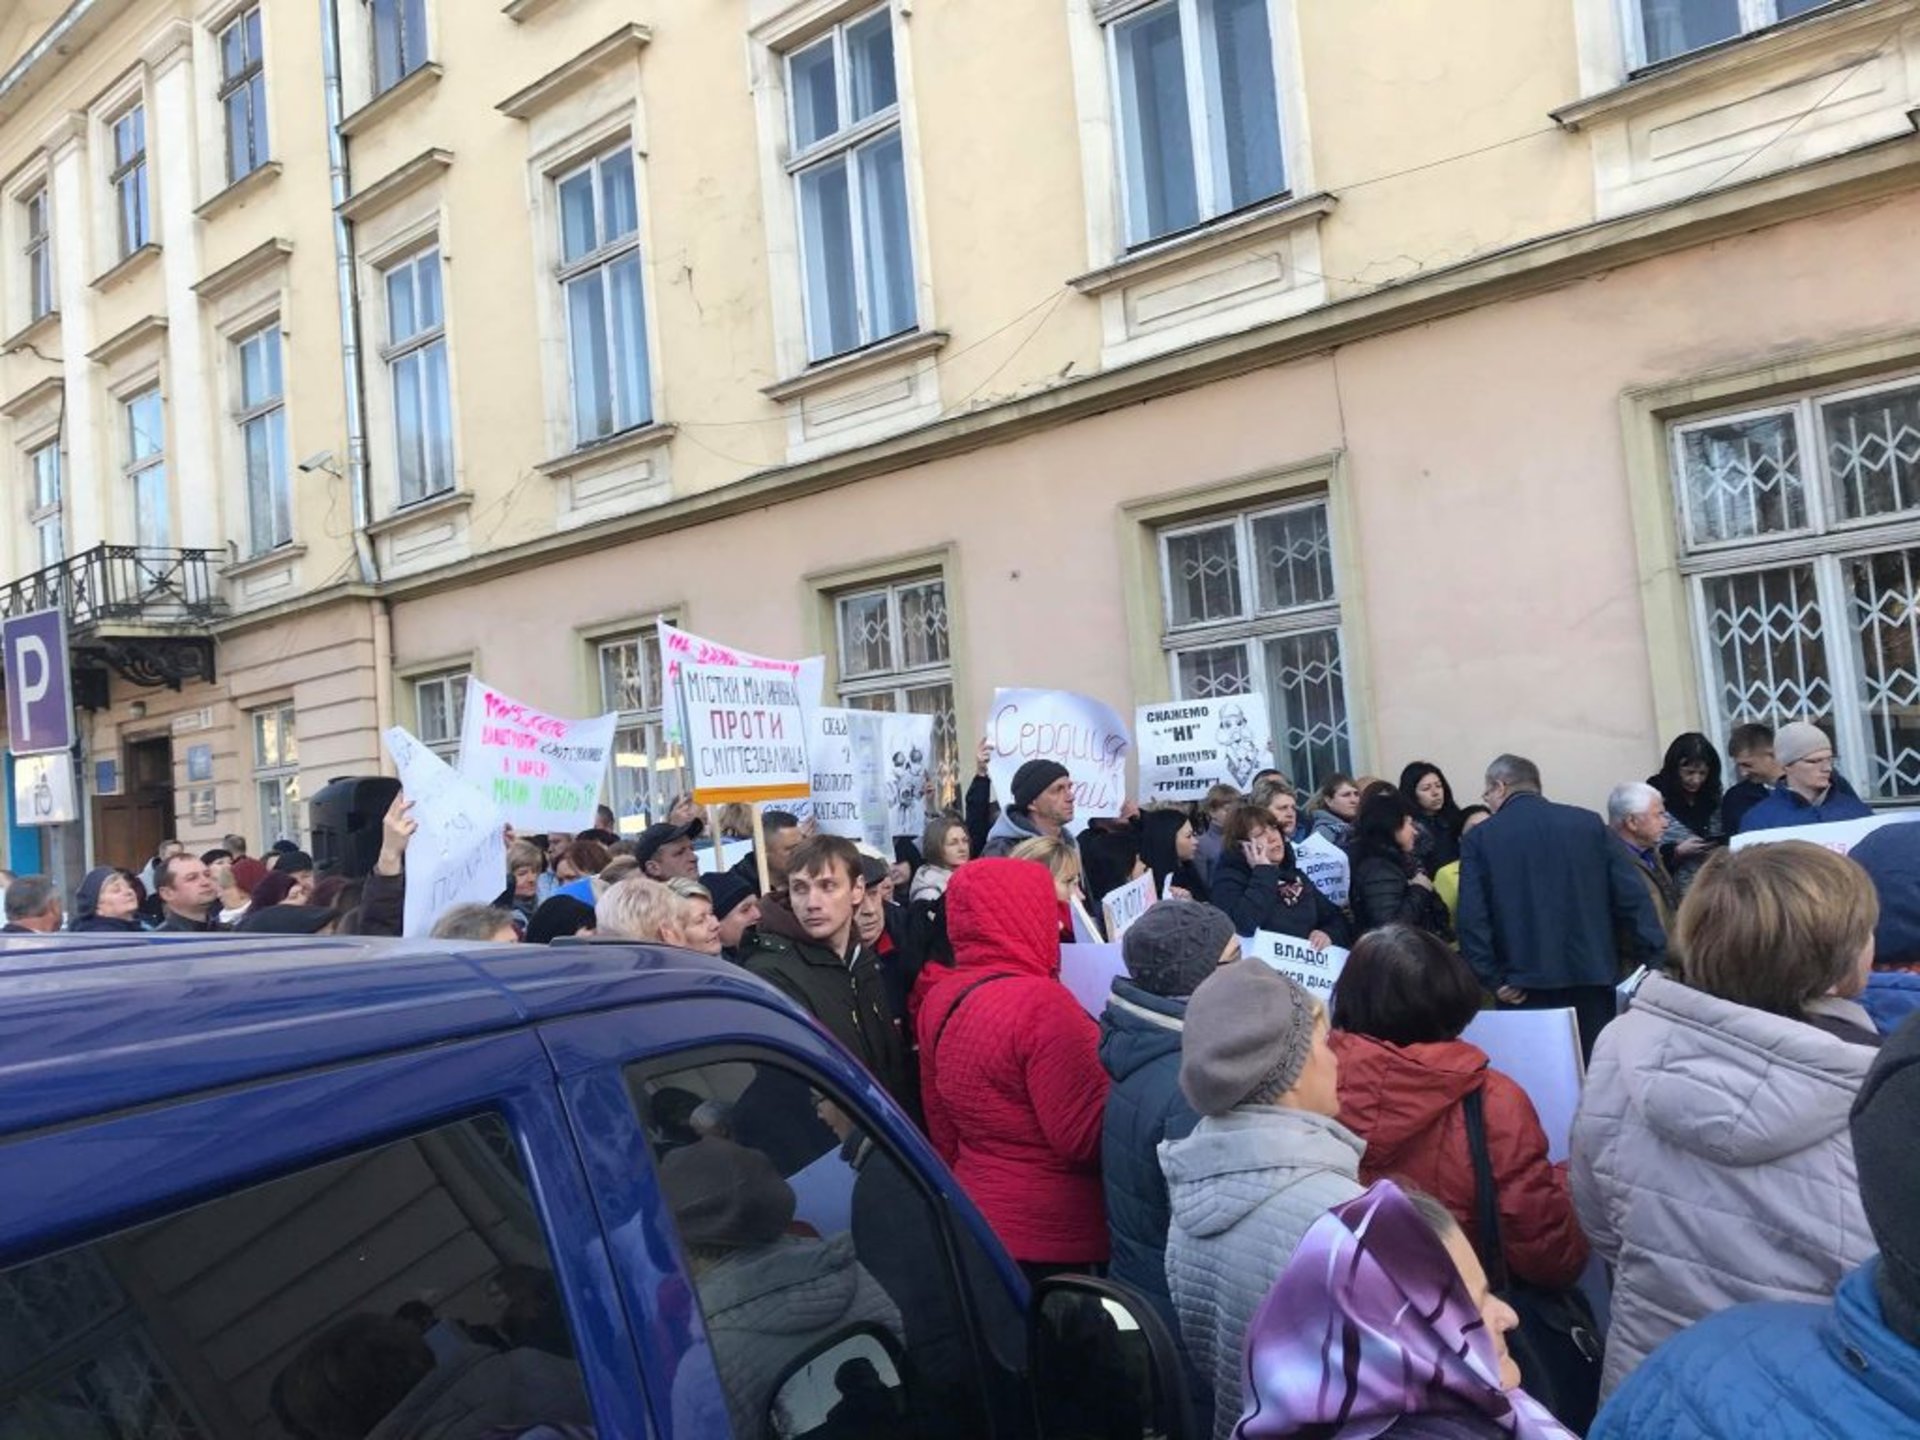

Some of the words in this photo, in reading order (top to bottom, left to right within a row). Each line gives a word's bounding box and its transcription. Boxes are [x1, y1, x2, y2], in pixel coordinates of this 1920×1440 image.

[15, 634, 50, 741] P
[710, 709, 784, 740] ПРОТИ
[1146, 706, 1209, 723] СКАЖЕМО
[1178, 766, 1194, 777] ТА
[1273, 941, 1329, 967] ВЛАДО!
